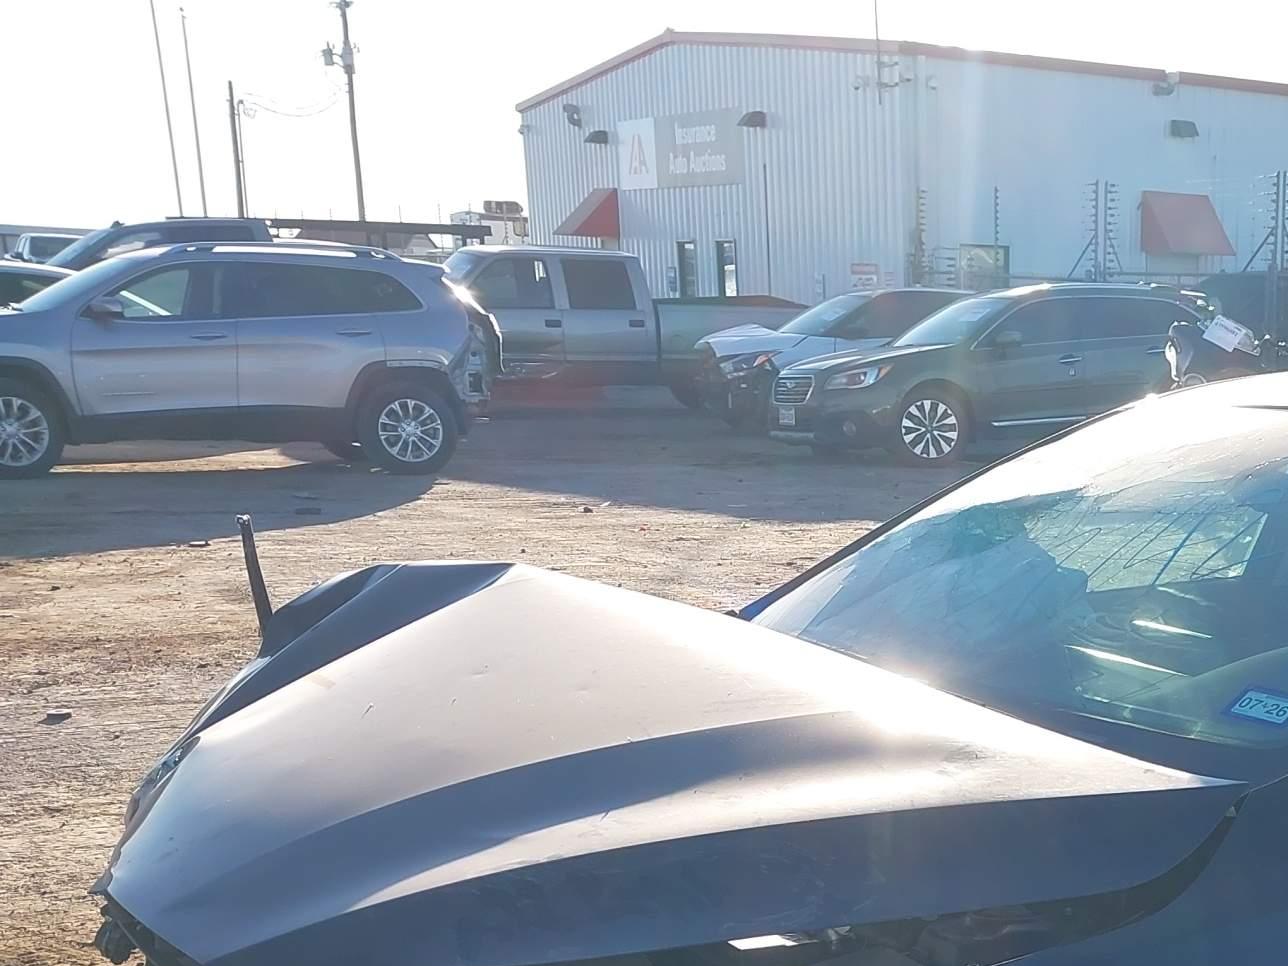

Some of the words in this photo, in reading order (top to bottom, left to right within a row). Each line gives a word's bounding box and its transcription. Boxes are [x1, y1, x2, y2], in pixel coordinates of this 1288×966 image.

[674, 121, 717, 144] Insurance
[668, 152, 688, 175] Auto
[689, 149, 727, 172] Auctions
